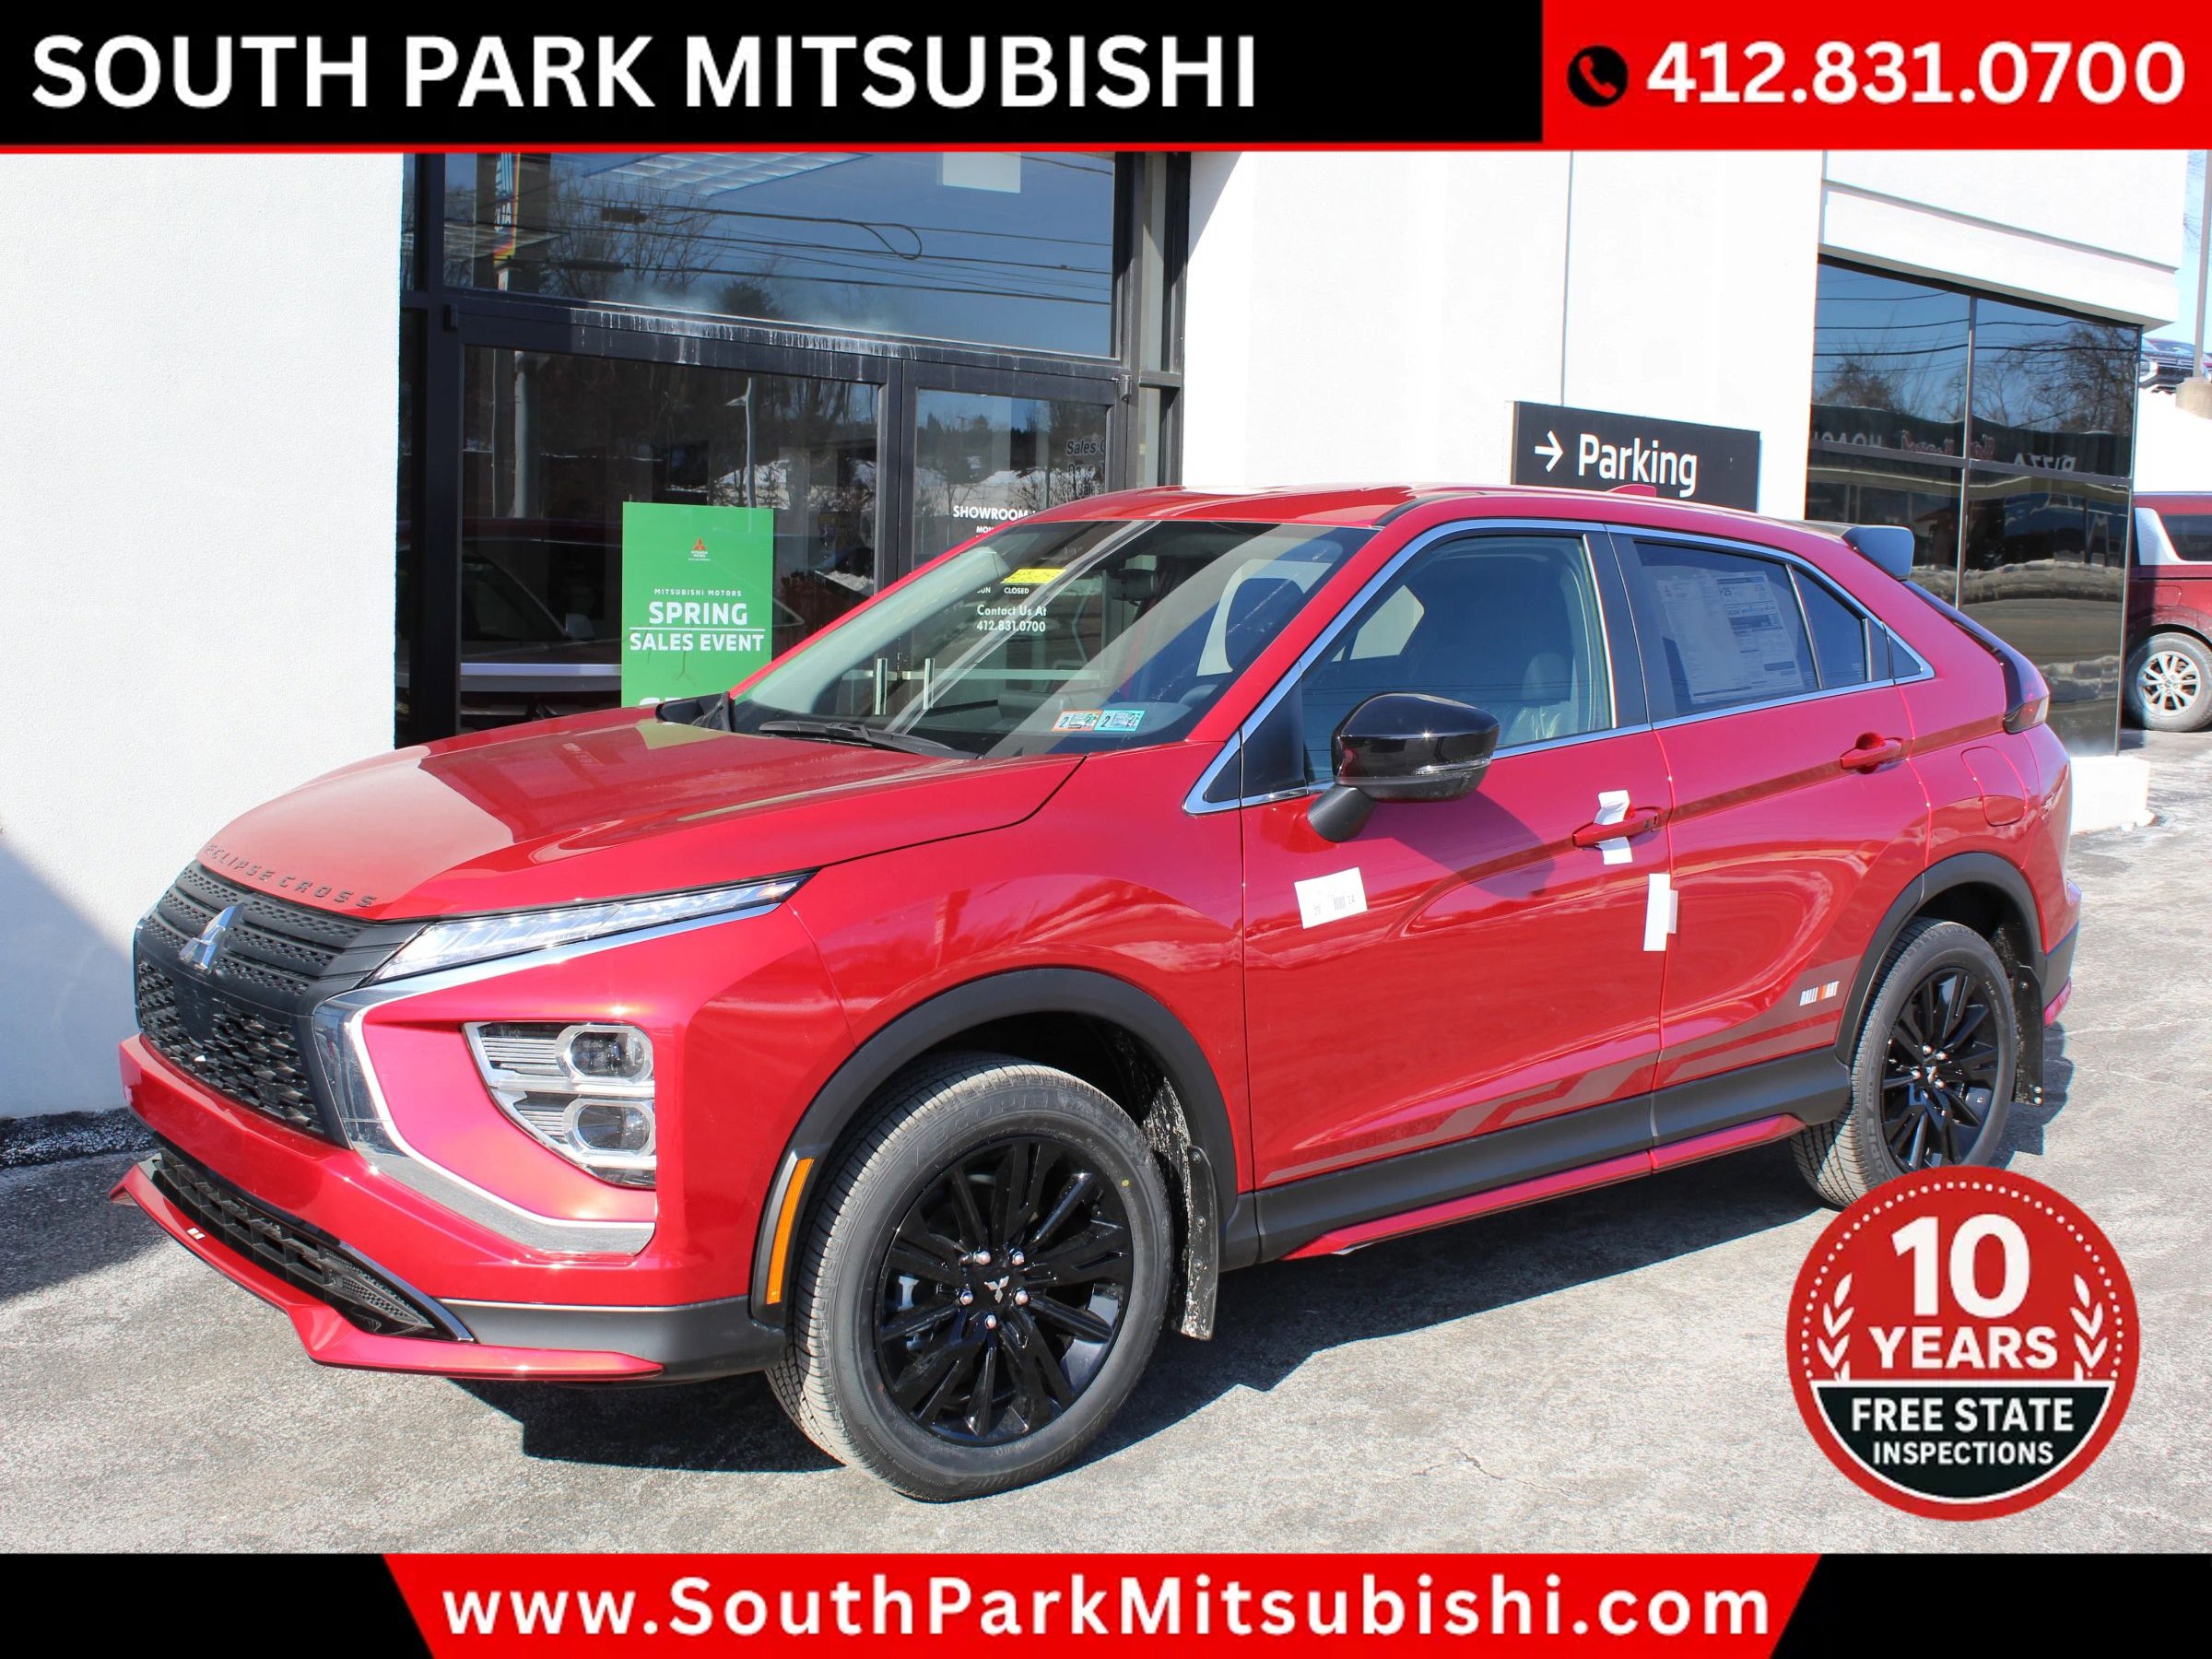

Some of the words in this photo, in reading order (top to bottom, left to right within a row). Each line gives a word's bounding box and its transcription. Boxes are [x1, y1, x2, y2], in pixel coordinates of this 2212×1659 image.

[1066, 440, 1096, 455] Sales
[1578, 433, 1698, 498] Parking
[953, 505, 1028, 521] SHOWROOM
[653, 588, 704, 596] MITSUBISHI
[708, 589, 742, 597] MOTORS
[648, 601, 747, 626] SPRING
[977, 604, 1016, 617] Contact
[1018, 605, 1032, 617] Us
[1034, 606, 1047, 617] At
[976, 619, 1046, 632] 412.831.0700
[629, 632, 694, 651] SALES
[700, 633, 764, 652] EVENT
[206, 843, 276, 882] ECLIPSE
[278, 874, 377, 908] CROSS
